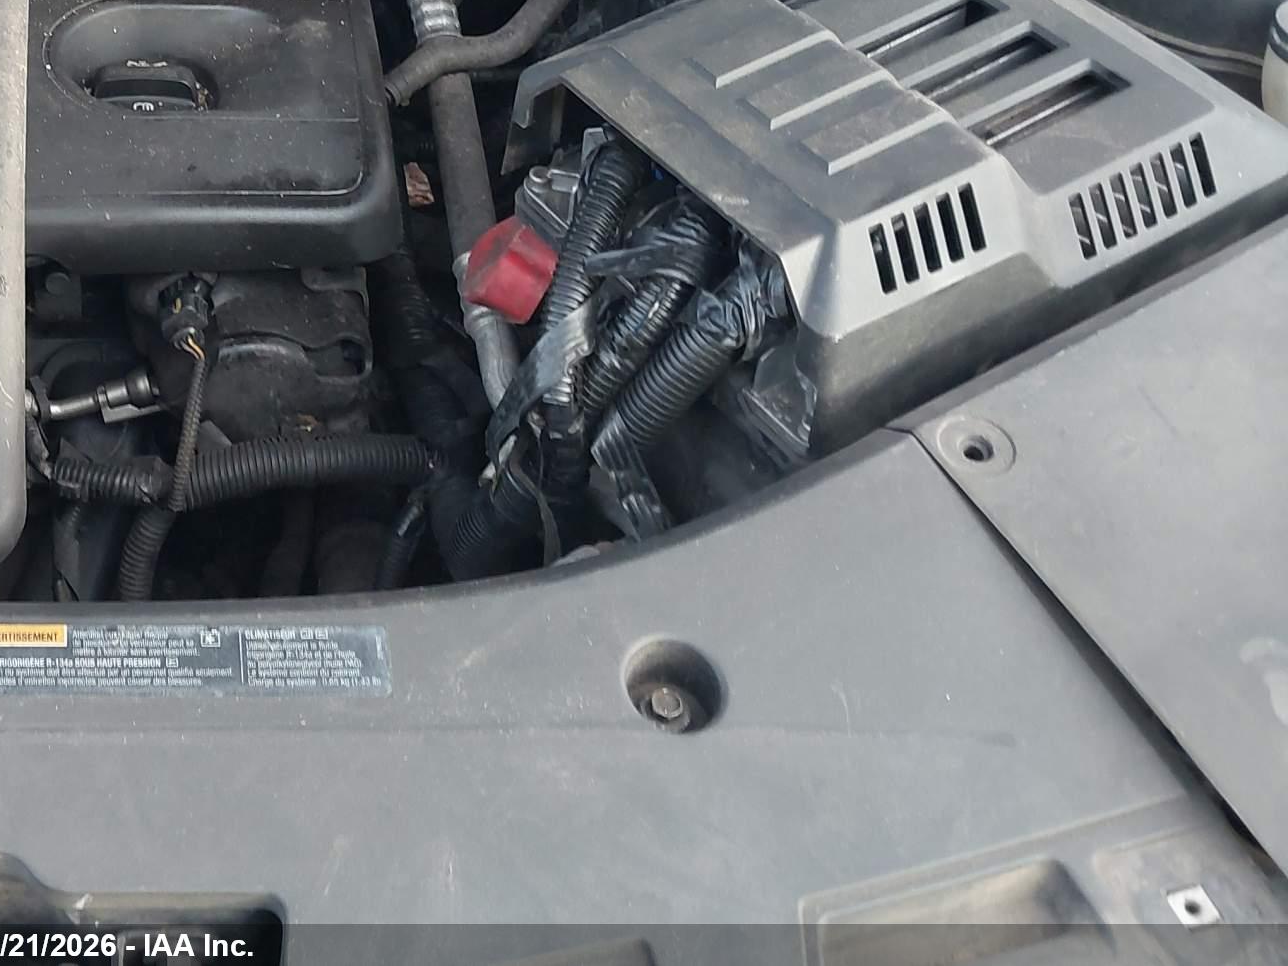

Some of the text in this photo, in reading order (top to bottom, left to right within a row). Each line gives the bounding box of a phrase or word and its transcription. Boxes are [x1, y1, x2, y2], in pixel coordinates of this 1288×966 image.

[46, 658, 73, 668] R-134a
[75, 658, 96, 668] SOUS
[97, 658, 122, 668] HAUTE
[123, 658, 161, 668] PRESSION
